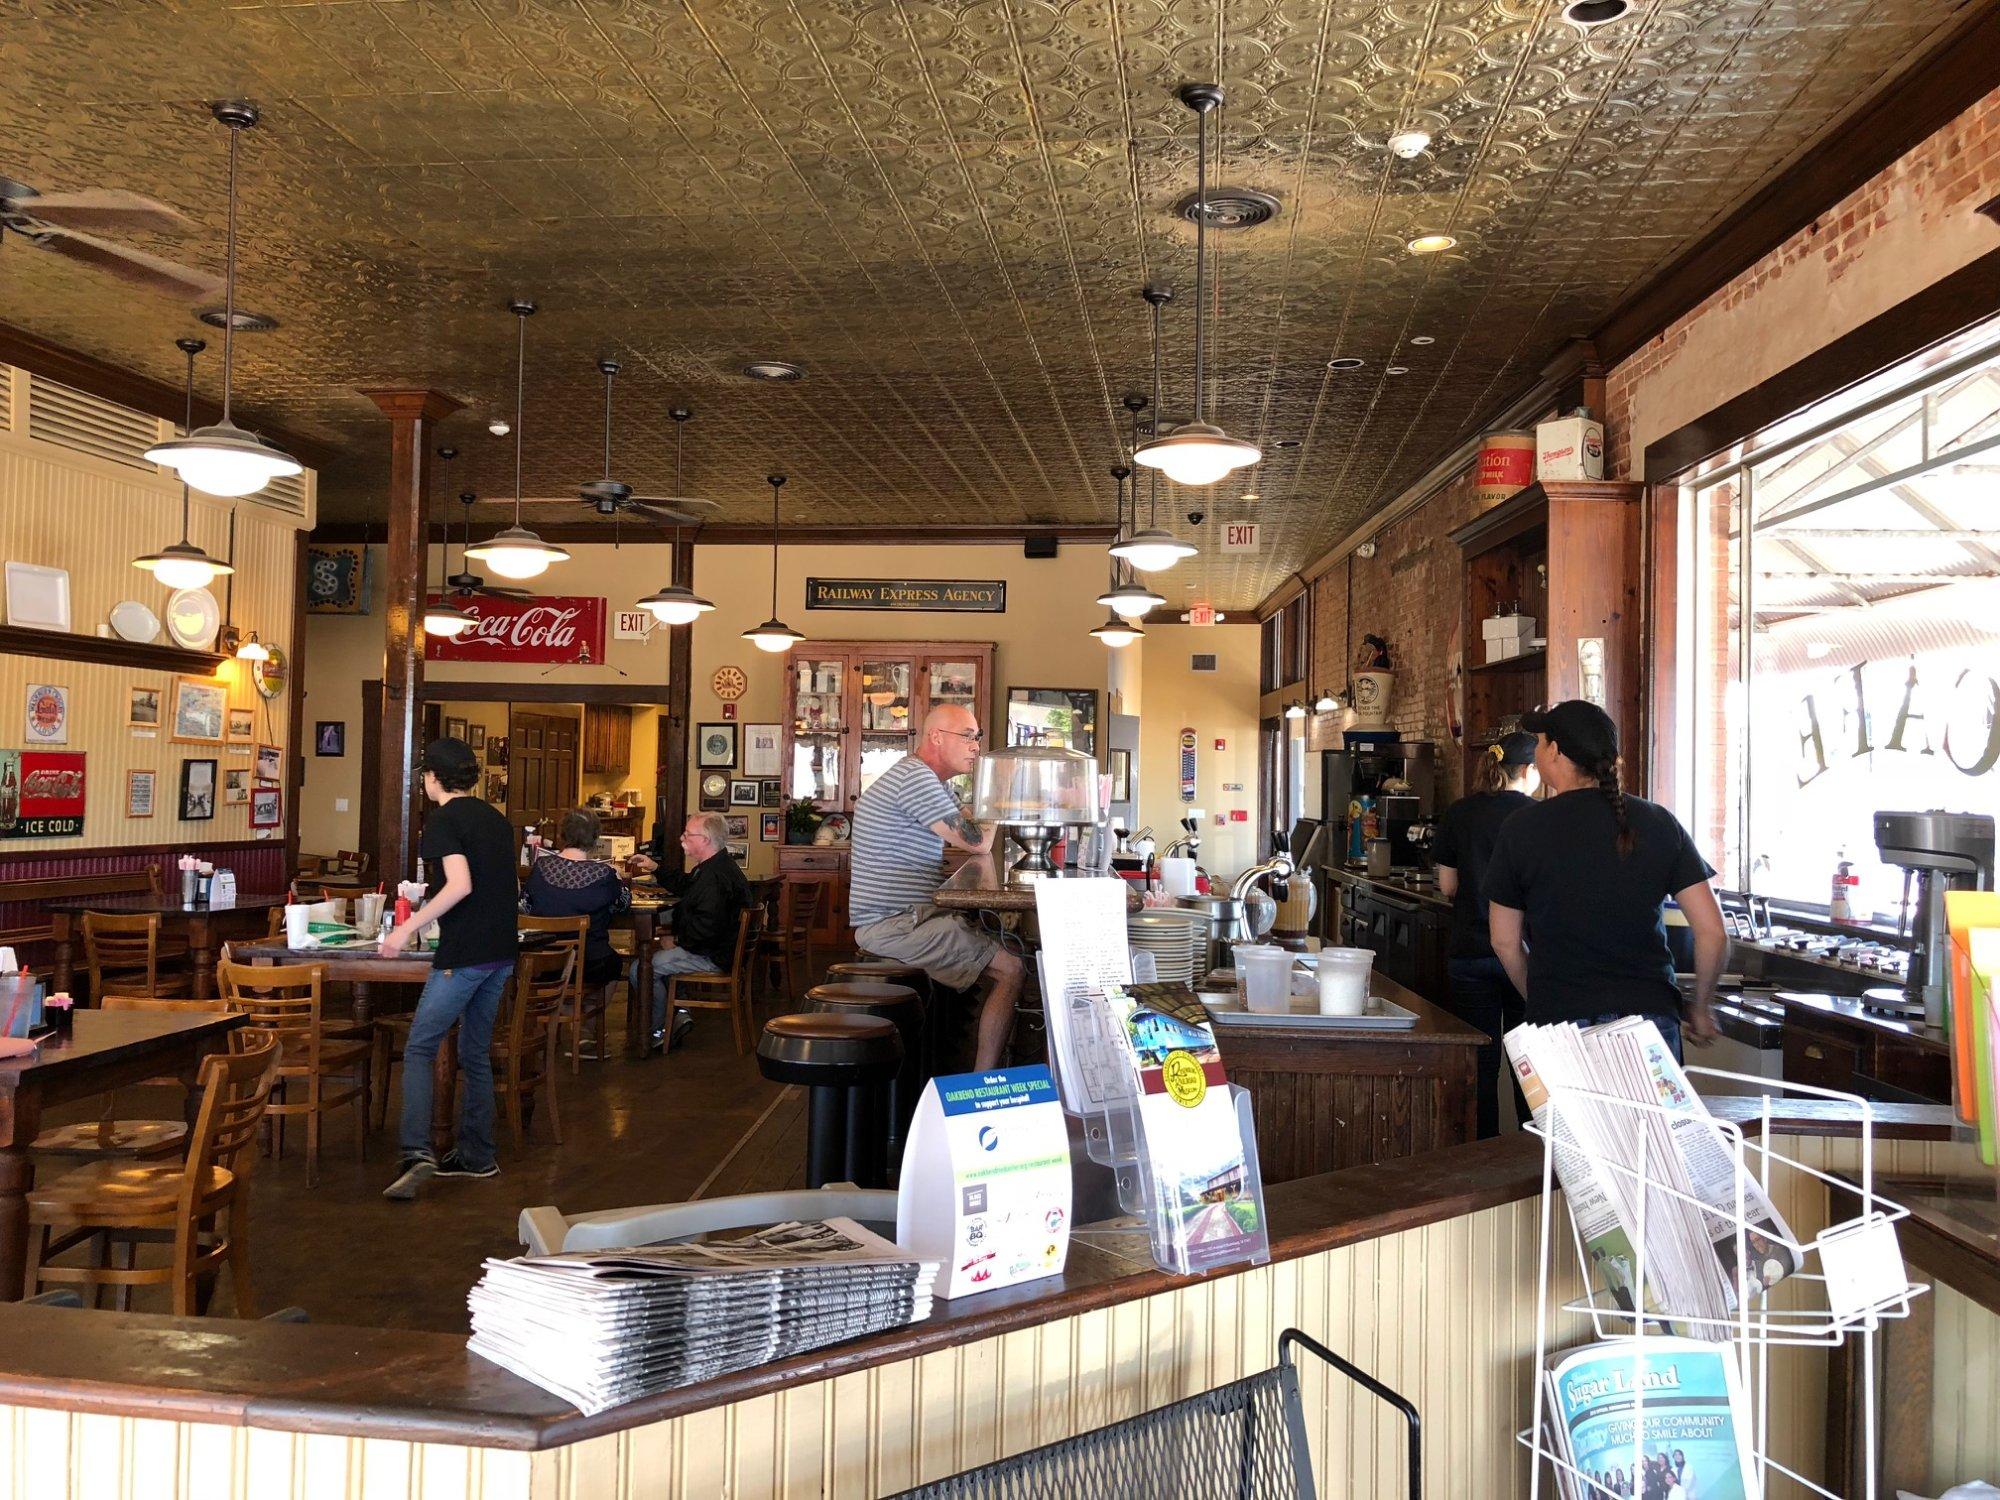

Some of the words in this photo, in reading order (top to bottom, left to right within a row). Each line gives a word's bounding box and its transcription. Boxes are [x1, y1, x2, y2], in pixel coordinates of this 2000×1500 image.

[1228, 526, 1255, 545] EXIT
[817, 586, 875, 600] RAILWAY
[880, 587, 938, 601] EXPRESS
[943, 588, 996, 602] AGENCY
[620, 613, 645, 632] EXIT
[1193, 611, 1211, 624] EXIT
[450, 605, 582, 648] Coca-Cola
[25, 821, 44, 834] ICE
[48, 820, 75, 833] COLD
[974, 1083, 1011, 1099] RESTAURANT
[1010, 1081, 1028, 1094] WEEK
[1027, 1079, 1051, 1092] SPECIAL
[1670, 1116, 1697, 1131] closu
[1726, 1191, 1755, 1210] naes
[1714, 1221, 1725, 1235] of
[1567, 1374, 1610, 1411] Sugar
[1663, 1416, 1725, 1427] COMMUNITY
[1651, 1428, 1678, 1440] SMILE
[1680, 1427, 1713, 1439] ABOUT
